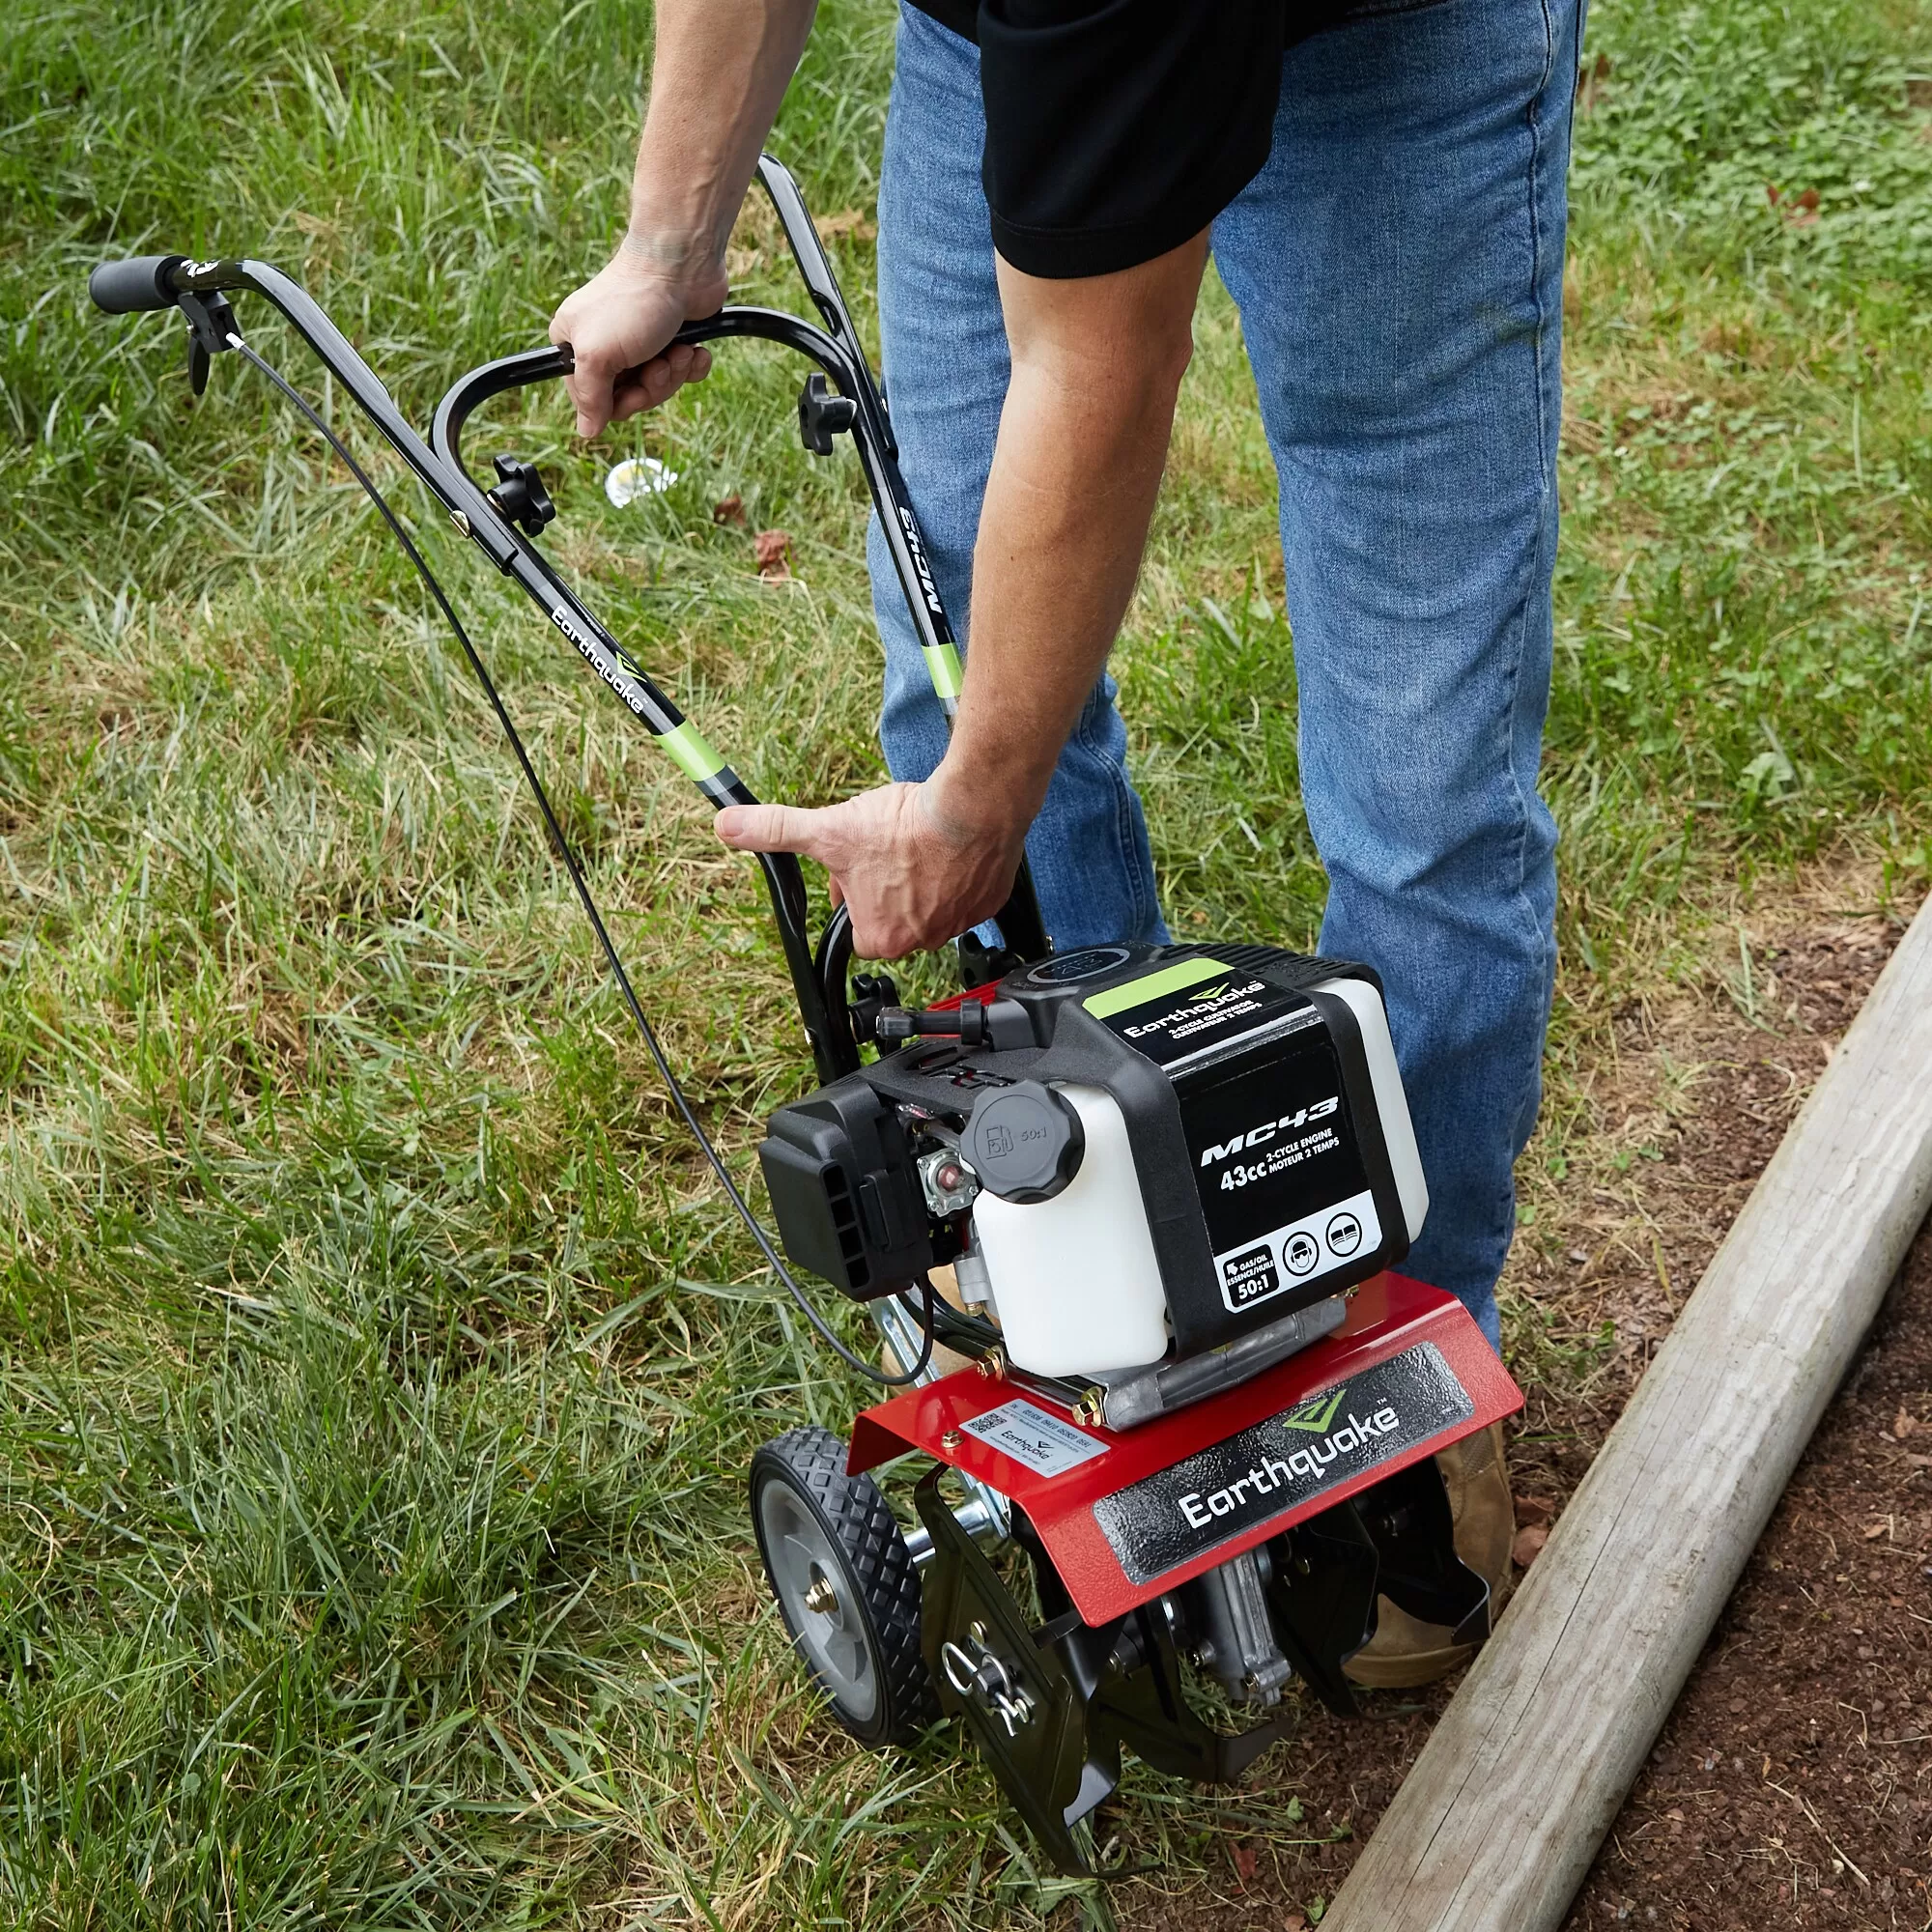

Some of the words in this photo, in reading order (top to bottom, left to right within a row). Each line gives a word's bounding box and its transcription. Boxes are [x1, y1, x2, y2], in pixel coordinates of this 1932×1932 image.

[899, 507, 943, 613] MC43
[552, 605, 644, 714] Earthquake
[1123, 981, 1265, 1038] Earthquake
[1168, 1018, 1205, 1035] 2-CYCLE
[1203, 999, 1254, 1021] CULTIVATOR
[1172, 1015, 1228, 1039] CULTIVATEUR
[1201, 1095, 1339, 1167] MC43
[1265, 1141, 1300, 1163] 2-CYCLE
[1300, 1127, 1333, 1148] ENGINE
[1268, 1152, 1304, 1174] MOTEUR
[1305, 1149, 1312, 1158] 2
[1312, 1136, 1340, 1154] TEMPS
[1220, 1162, 1267, 1190] 43cc
[1227, 1260, 1275, 1286] ESSENCE/HUILE
[1239, 1254, 1267, 1271] GAS/OIL
[1237, 1273, 1269, 1299] 50:1
[1001, 1430, 1050, 1460] Earthquake
[1179, 1406, 1400, 1528] Earthquake
